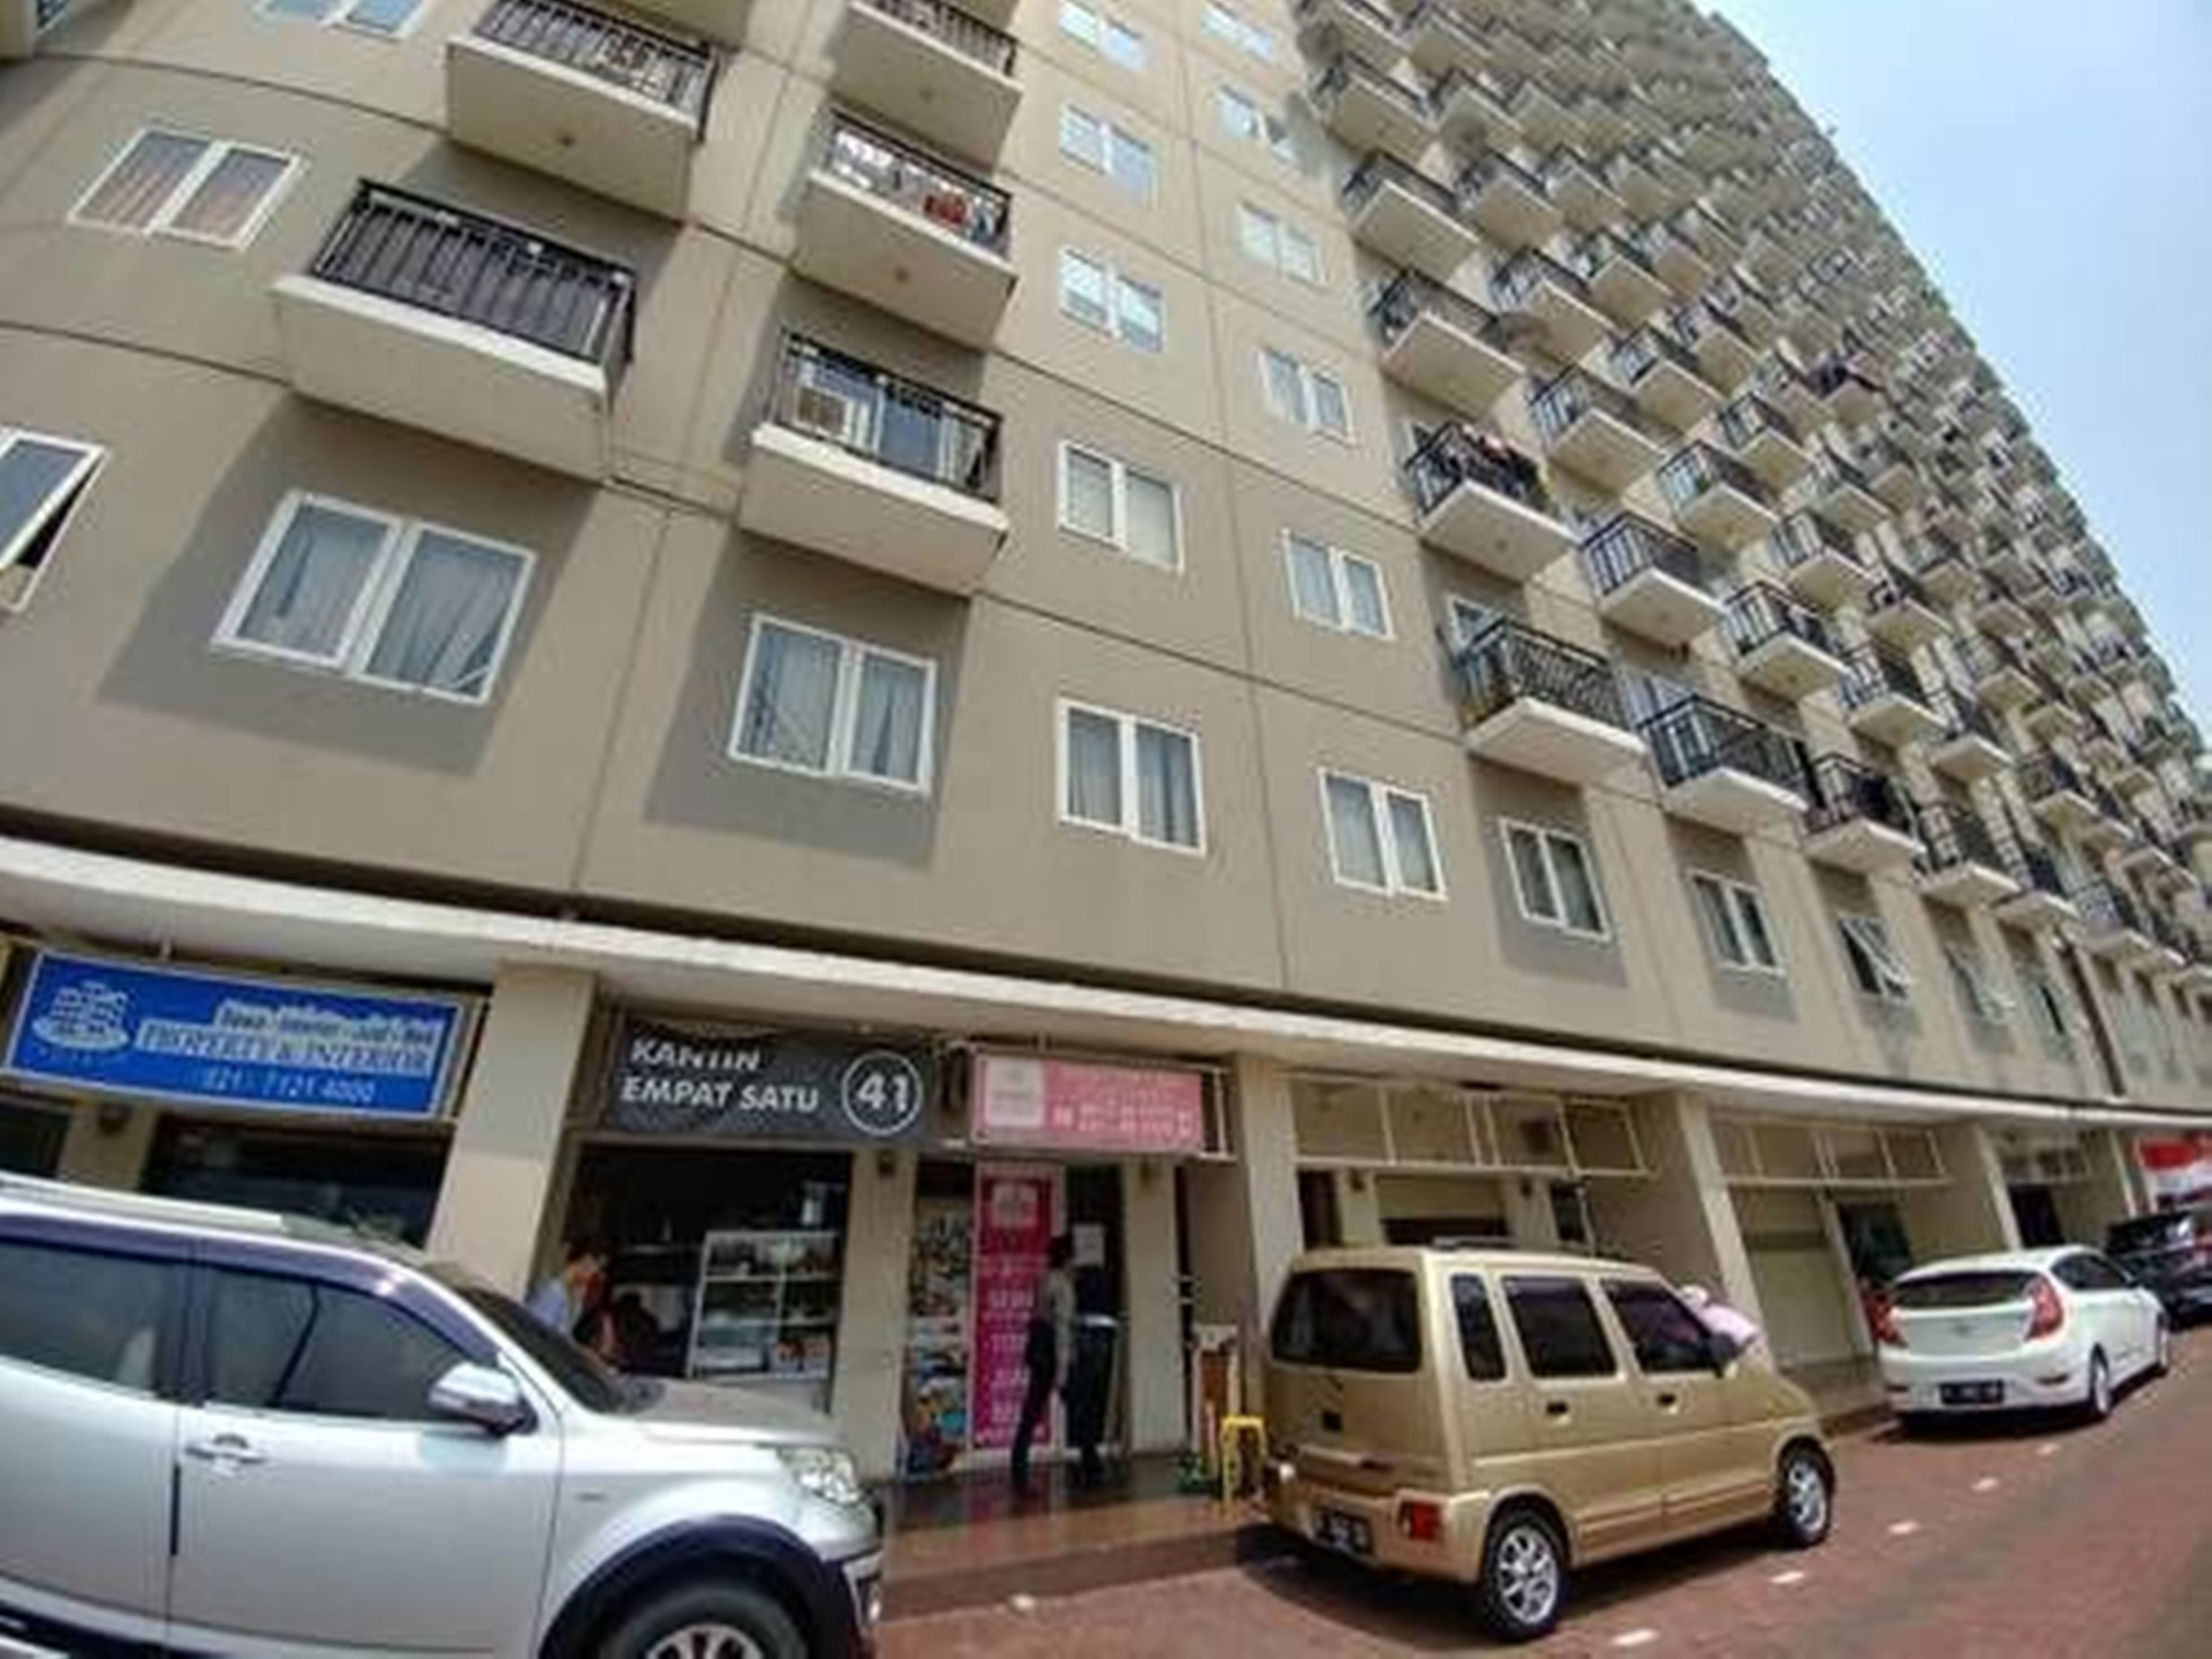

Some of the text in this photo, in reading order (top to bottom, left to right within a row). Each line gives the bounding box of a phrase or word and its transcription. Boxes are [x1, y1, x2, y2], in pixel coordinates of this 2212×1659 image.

[622, 1076, 818, 1113] EMPAT SATU
[857, 1073, 908, 1112] 41
